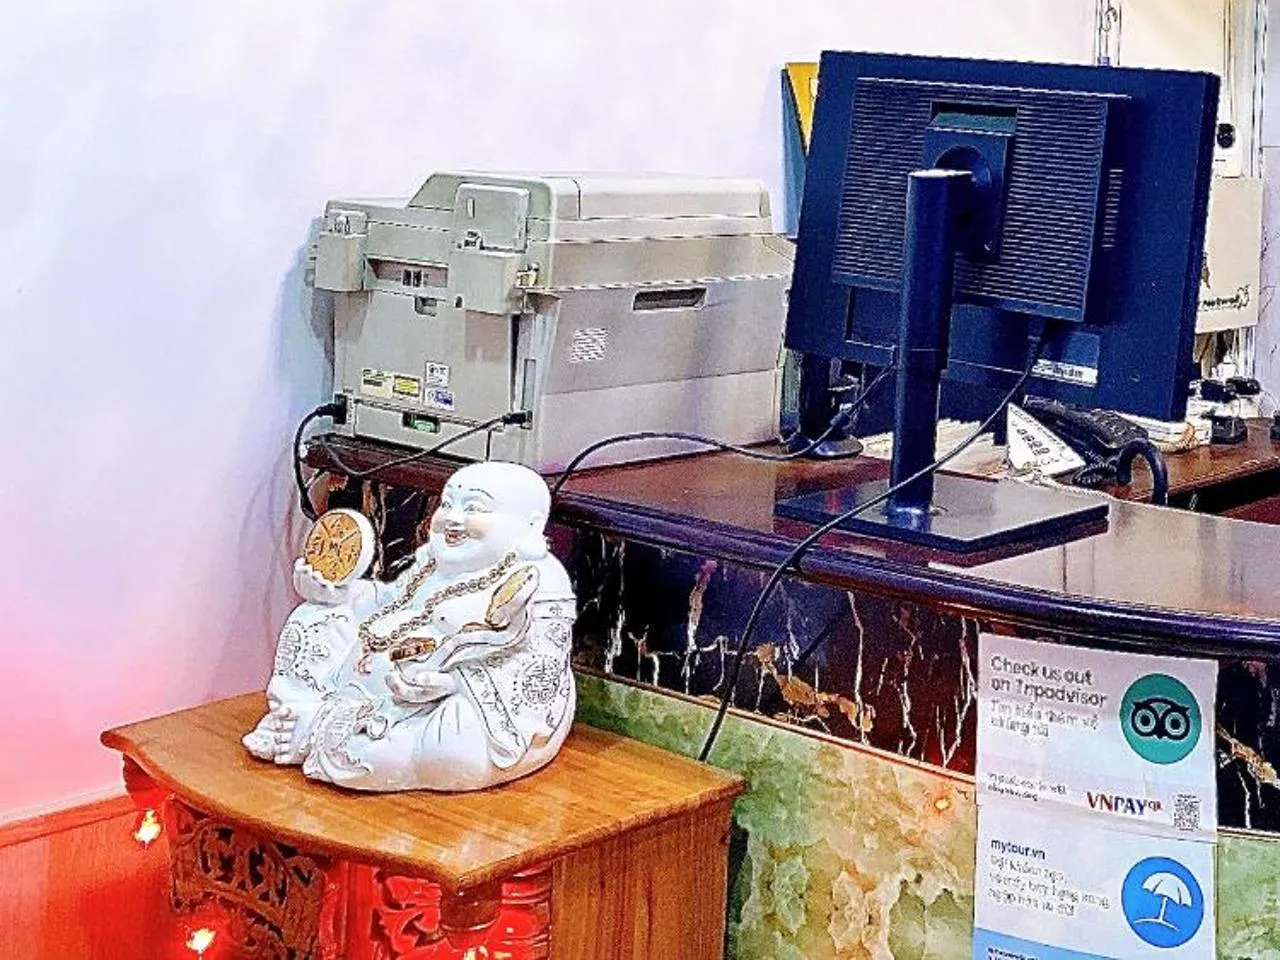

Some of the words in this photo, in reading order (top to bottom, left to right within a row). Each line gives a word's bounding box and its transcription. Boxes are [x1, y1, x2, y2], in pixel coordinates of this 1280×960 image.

[990, 655, 1040, 677] Check
[1042, 666, 1062, 681] us
[1063, 669, 1093, 685] out
[991, 678, 1010, 691] on
[1016, 679, 1107, 708] Tripadvisor
[1086, 791, 1148, 816] VNPAY
[991, 840, 1046, 860] mytour.vn
